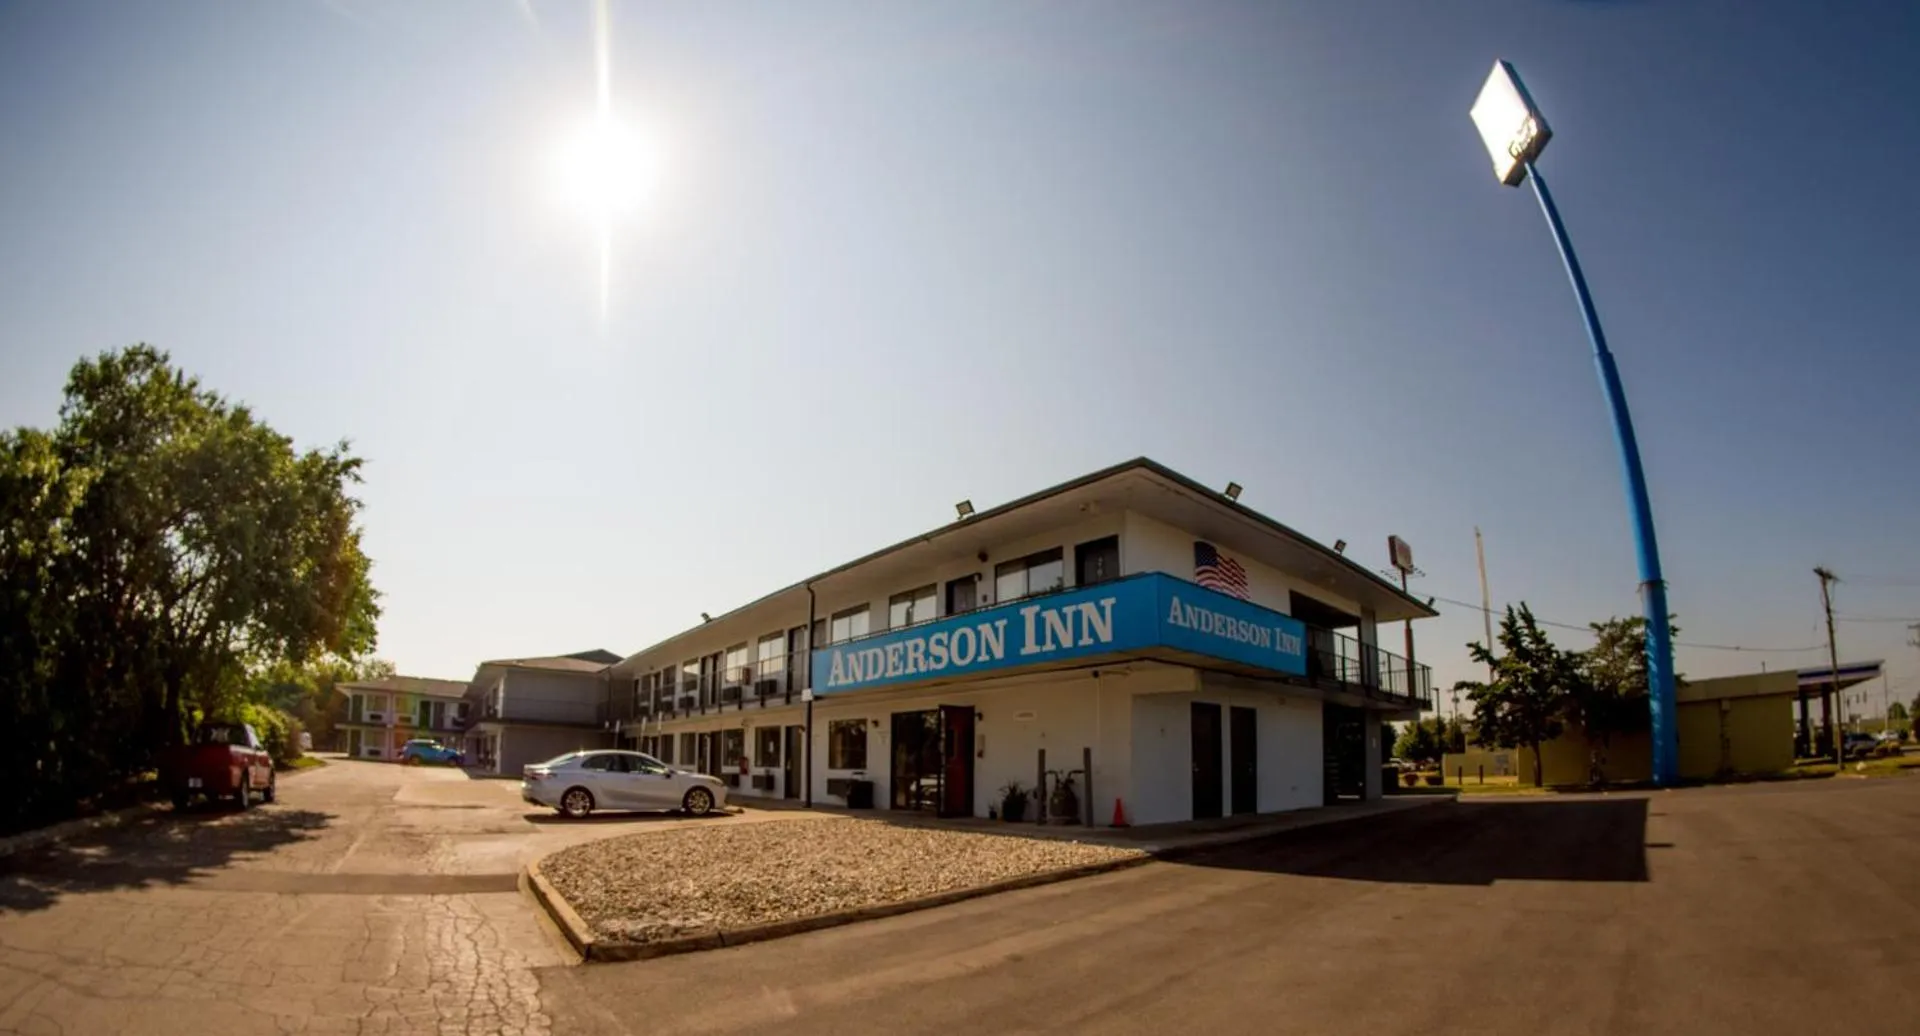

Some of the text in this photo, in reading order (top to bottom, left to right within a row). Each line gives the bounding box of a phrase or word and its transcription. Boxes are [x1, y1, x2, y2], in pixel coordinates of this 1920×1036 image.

[828, 597, 1117, 686] ANDERSON INN
[1168, 596, 1302, 656] ANDERSON INN
